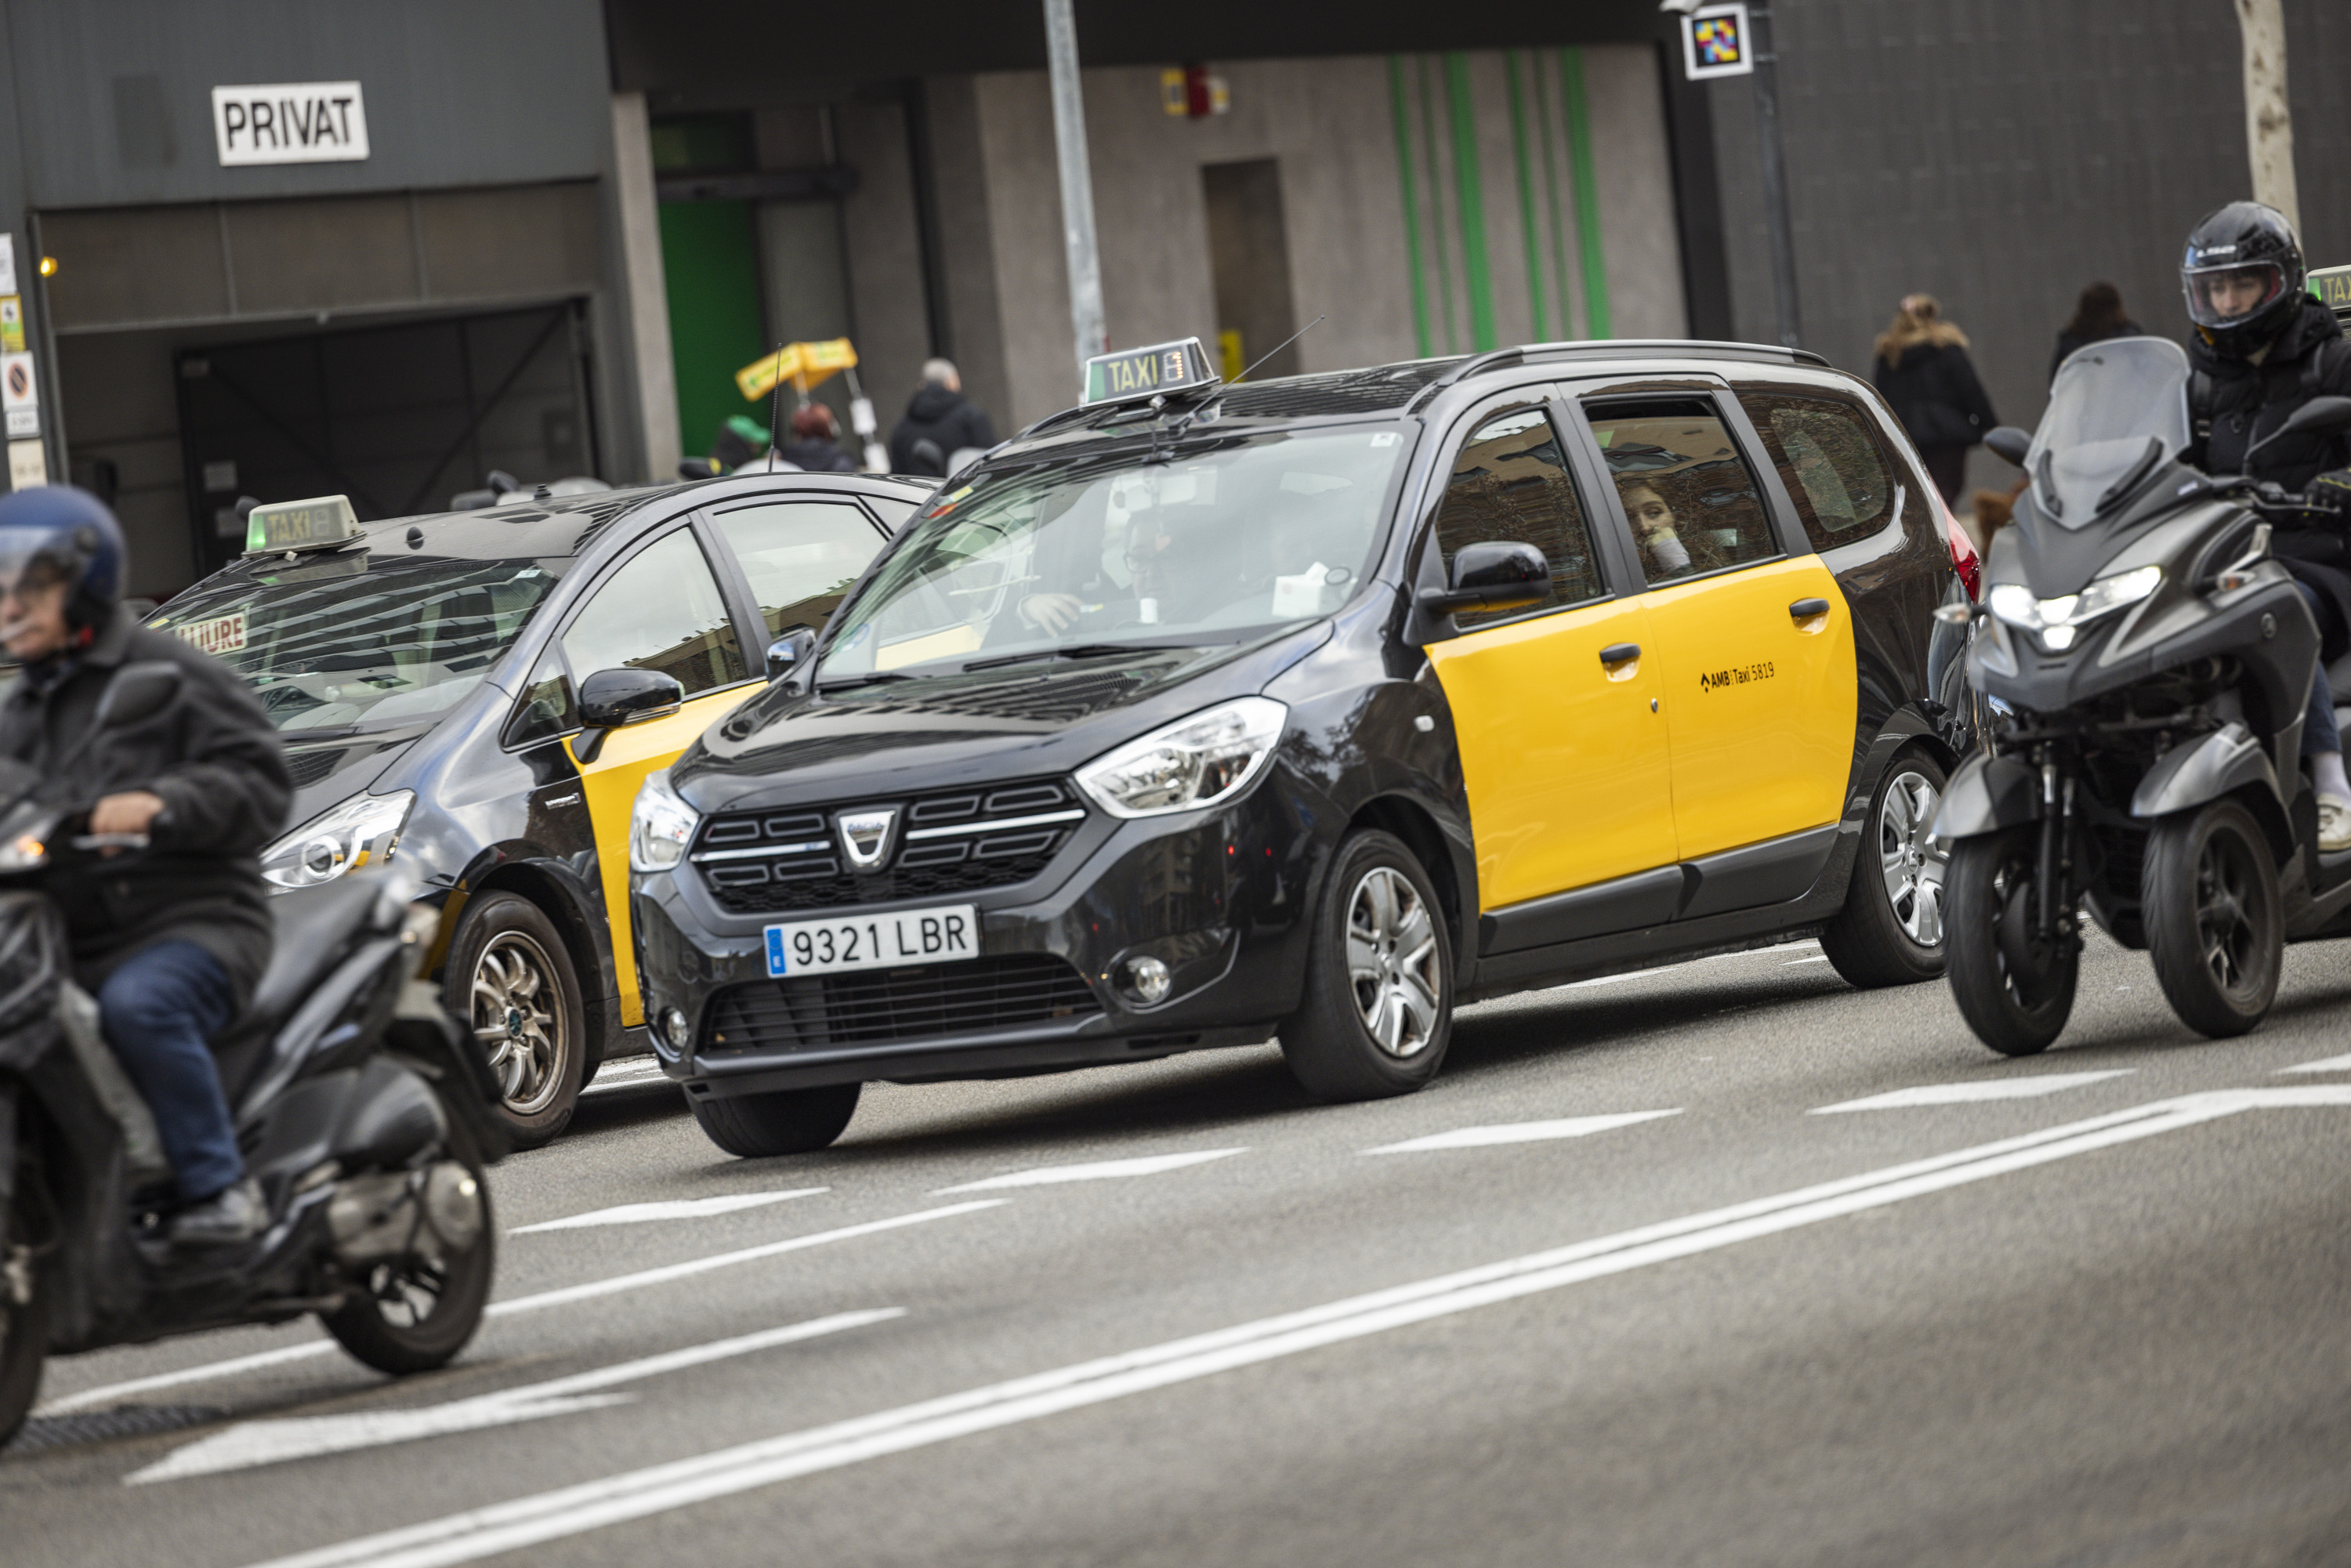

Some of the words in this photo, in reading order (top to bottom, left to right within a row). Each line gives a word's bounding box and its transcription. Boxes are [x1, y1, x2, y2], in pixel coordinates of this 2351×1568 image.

[224, 97, 352, 147] PRIVAT
[1107, 355, 1157, 393] TAXI
[267, 511, 311, 542] TAXI
[1711, 671, 1730, 689] AMB
[1733, 666, 1751, 684] Taxi
[1751, 661, 1774, 681] 5819
[794, 923, 878, 965] 9321
[897, 915, 966, 954] LBR
